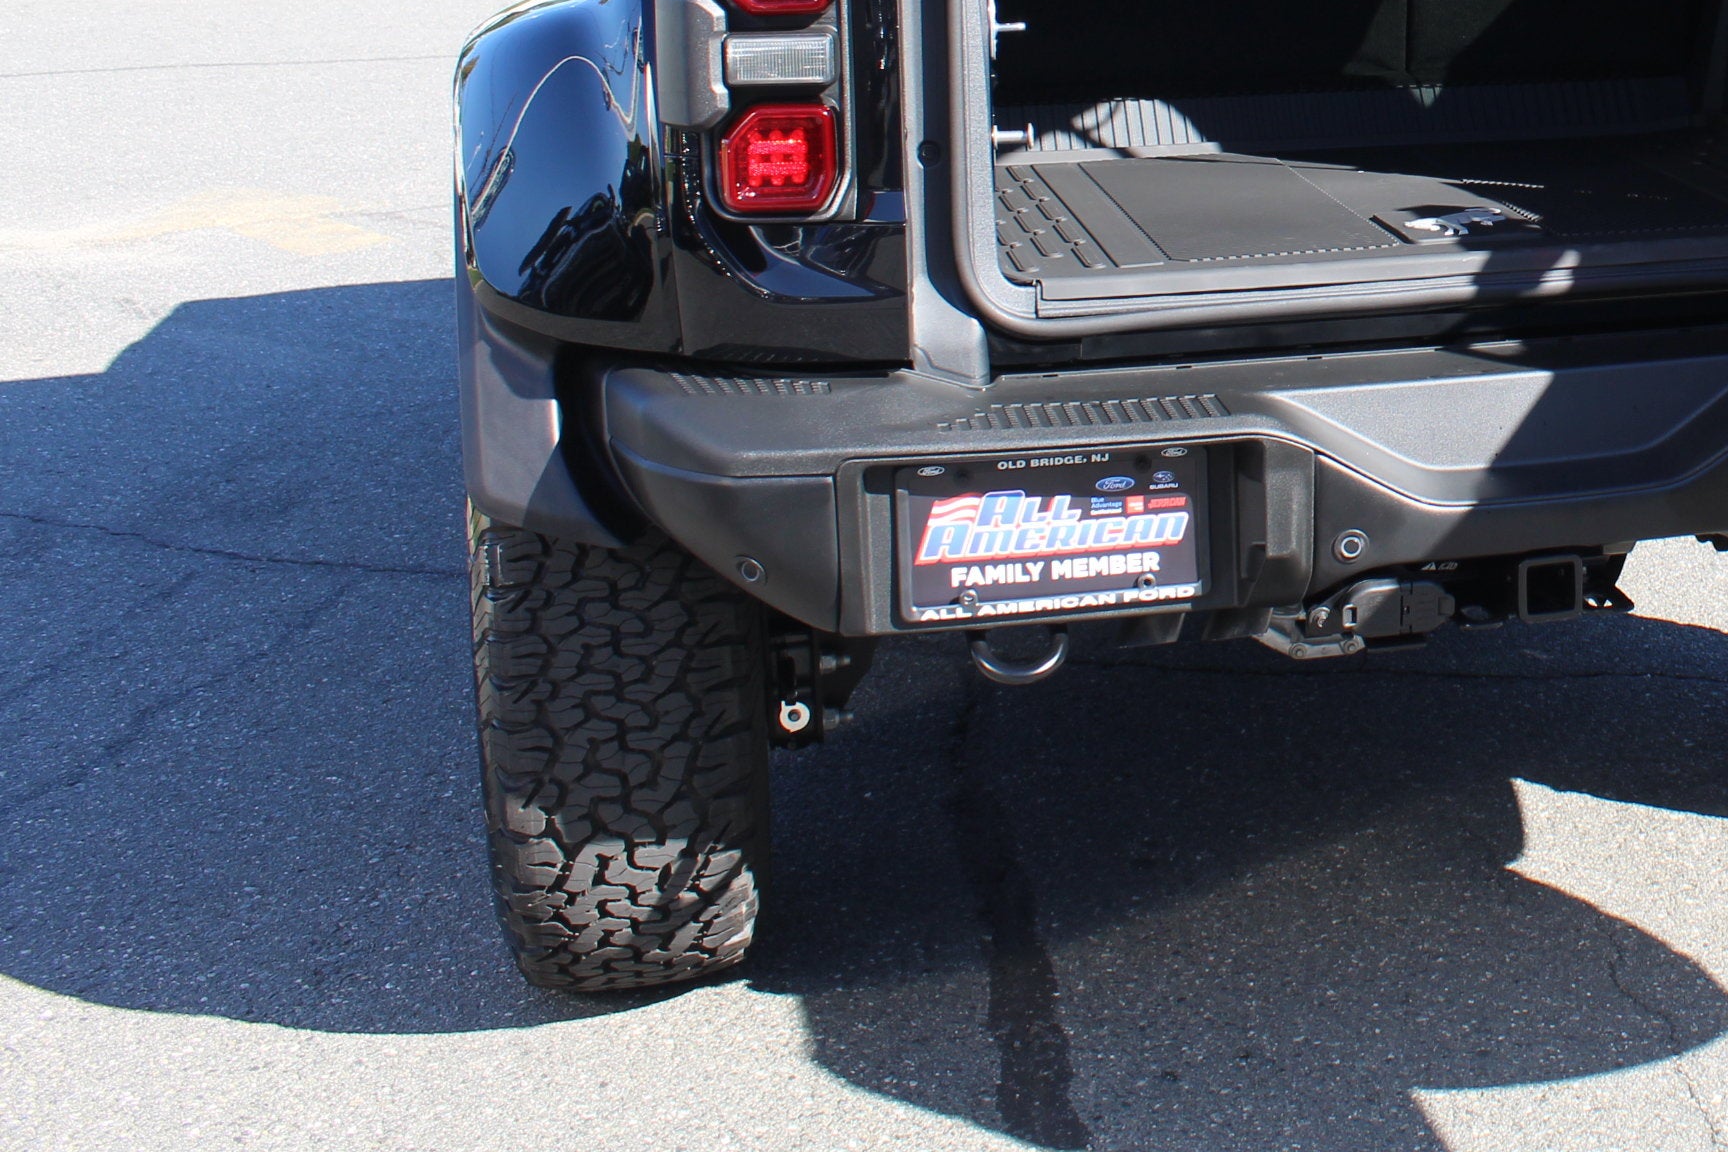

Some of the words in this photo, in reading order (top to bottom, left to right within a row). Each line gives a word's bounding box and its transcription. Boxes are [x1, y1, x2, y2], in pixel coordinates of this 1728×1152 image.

[997, 459, 1026, 470] OLD
[1030, 455, 1087, 468] BRIDGE,
[1091, 453, 1109, 463] NJ
[1102, 478, 1127, 490] Ford
[1091, 501, 1122, 510] Advantage
[951, 561, 1045, 588] FAMILY
[1051, 552, 1160, 580] MEMBER
[920, 608, 972, 622] ALL
[977, 594, 1117, 617] AMERICAN
[1123, 586, 1196, 603] FORD
